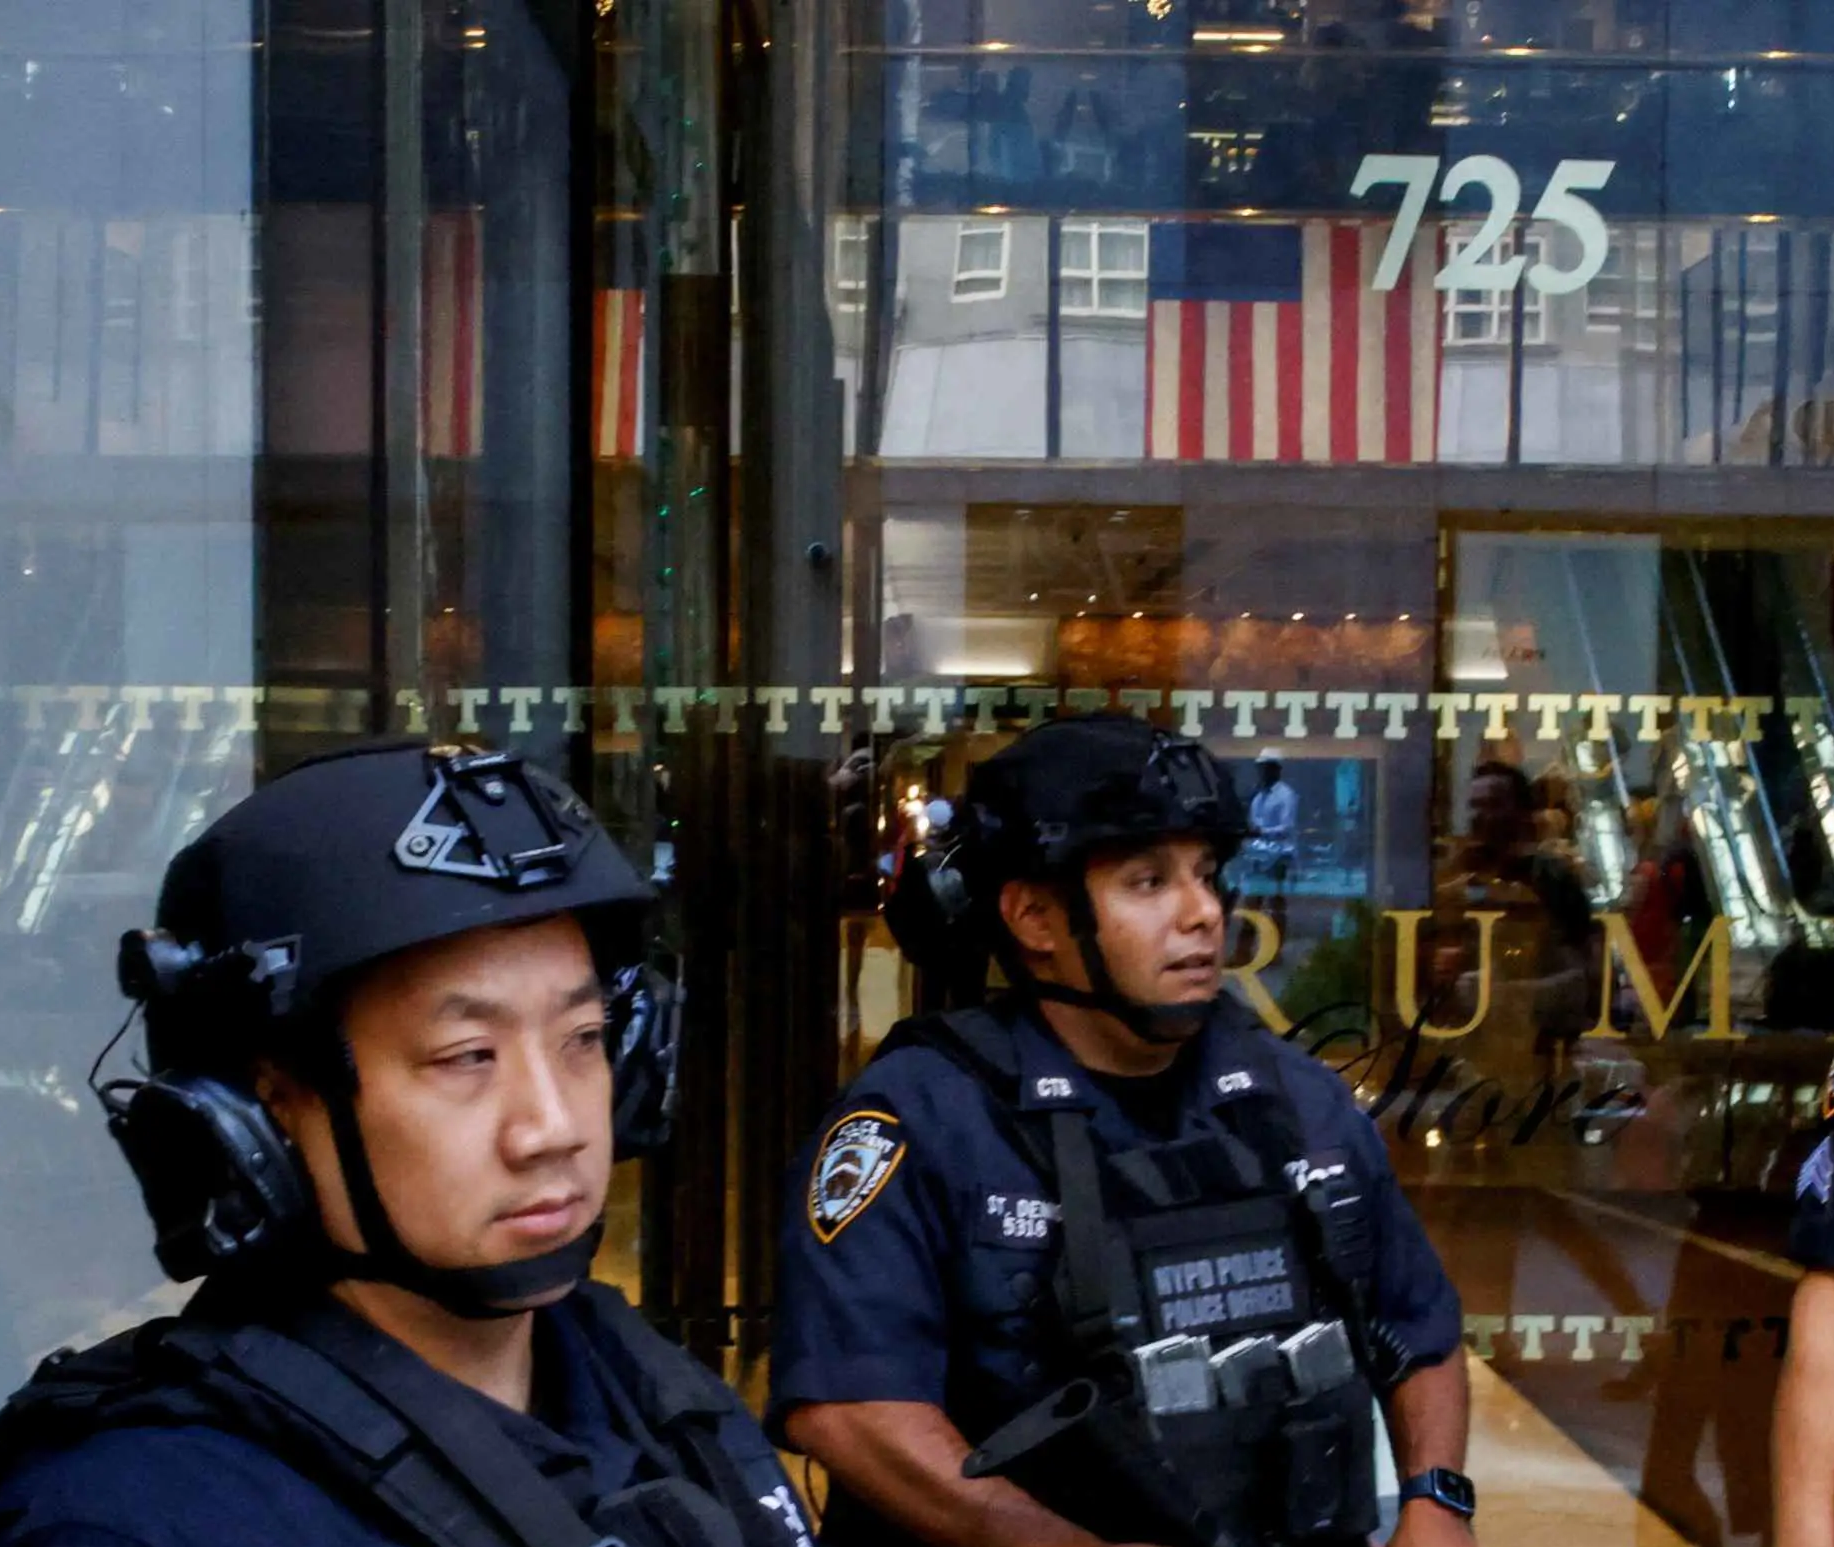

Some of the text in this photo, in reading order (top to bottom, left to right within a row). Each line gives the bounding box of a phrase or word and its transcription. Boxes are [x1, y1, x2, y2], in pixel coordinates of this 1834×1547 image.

[1350, 153, 1616, 296] 725
[1216, 1246, 1288, 1286] POLICE
[1160, 1292, 1227, 1333] POLICE
